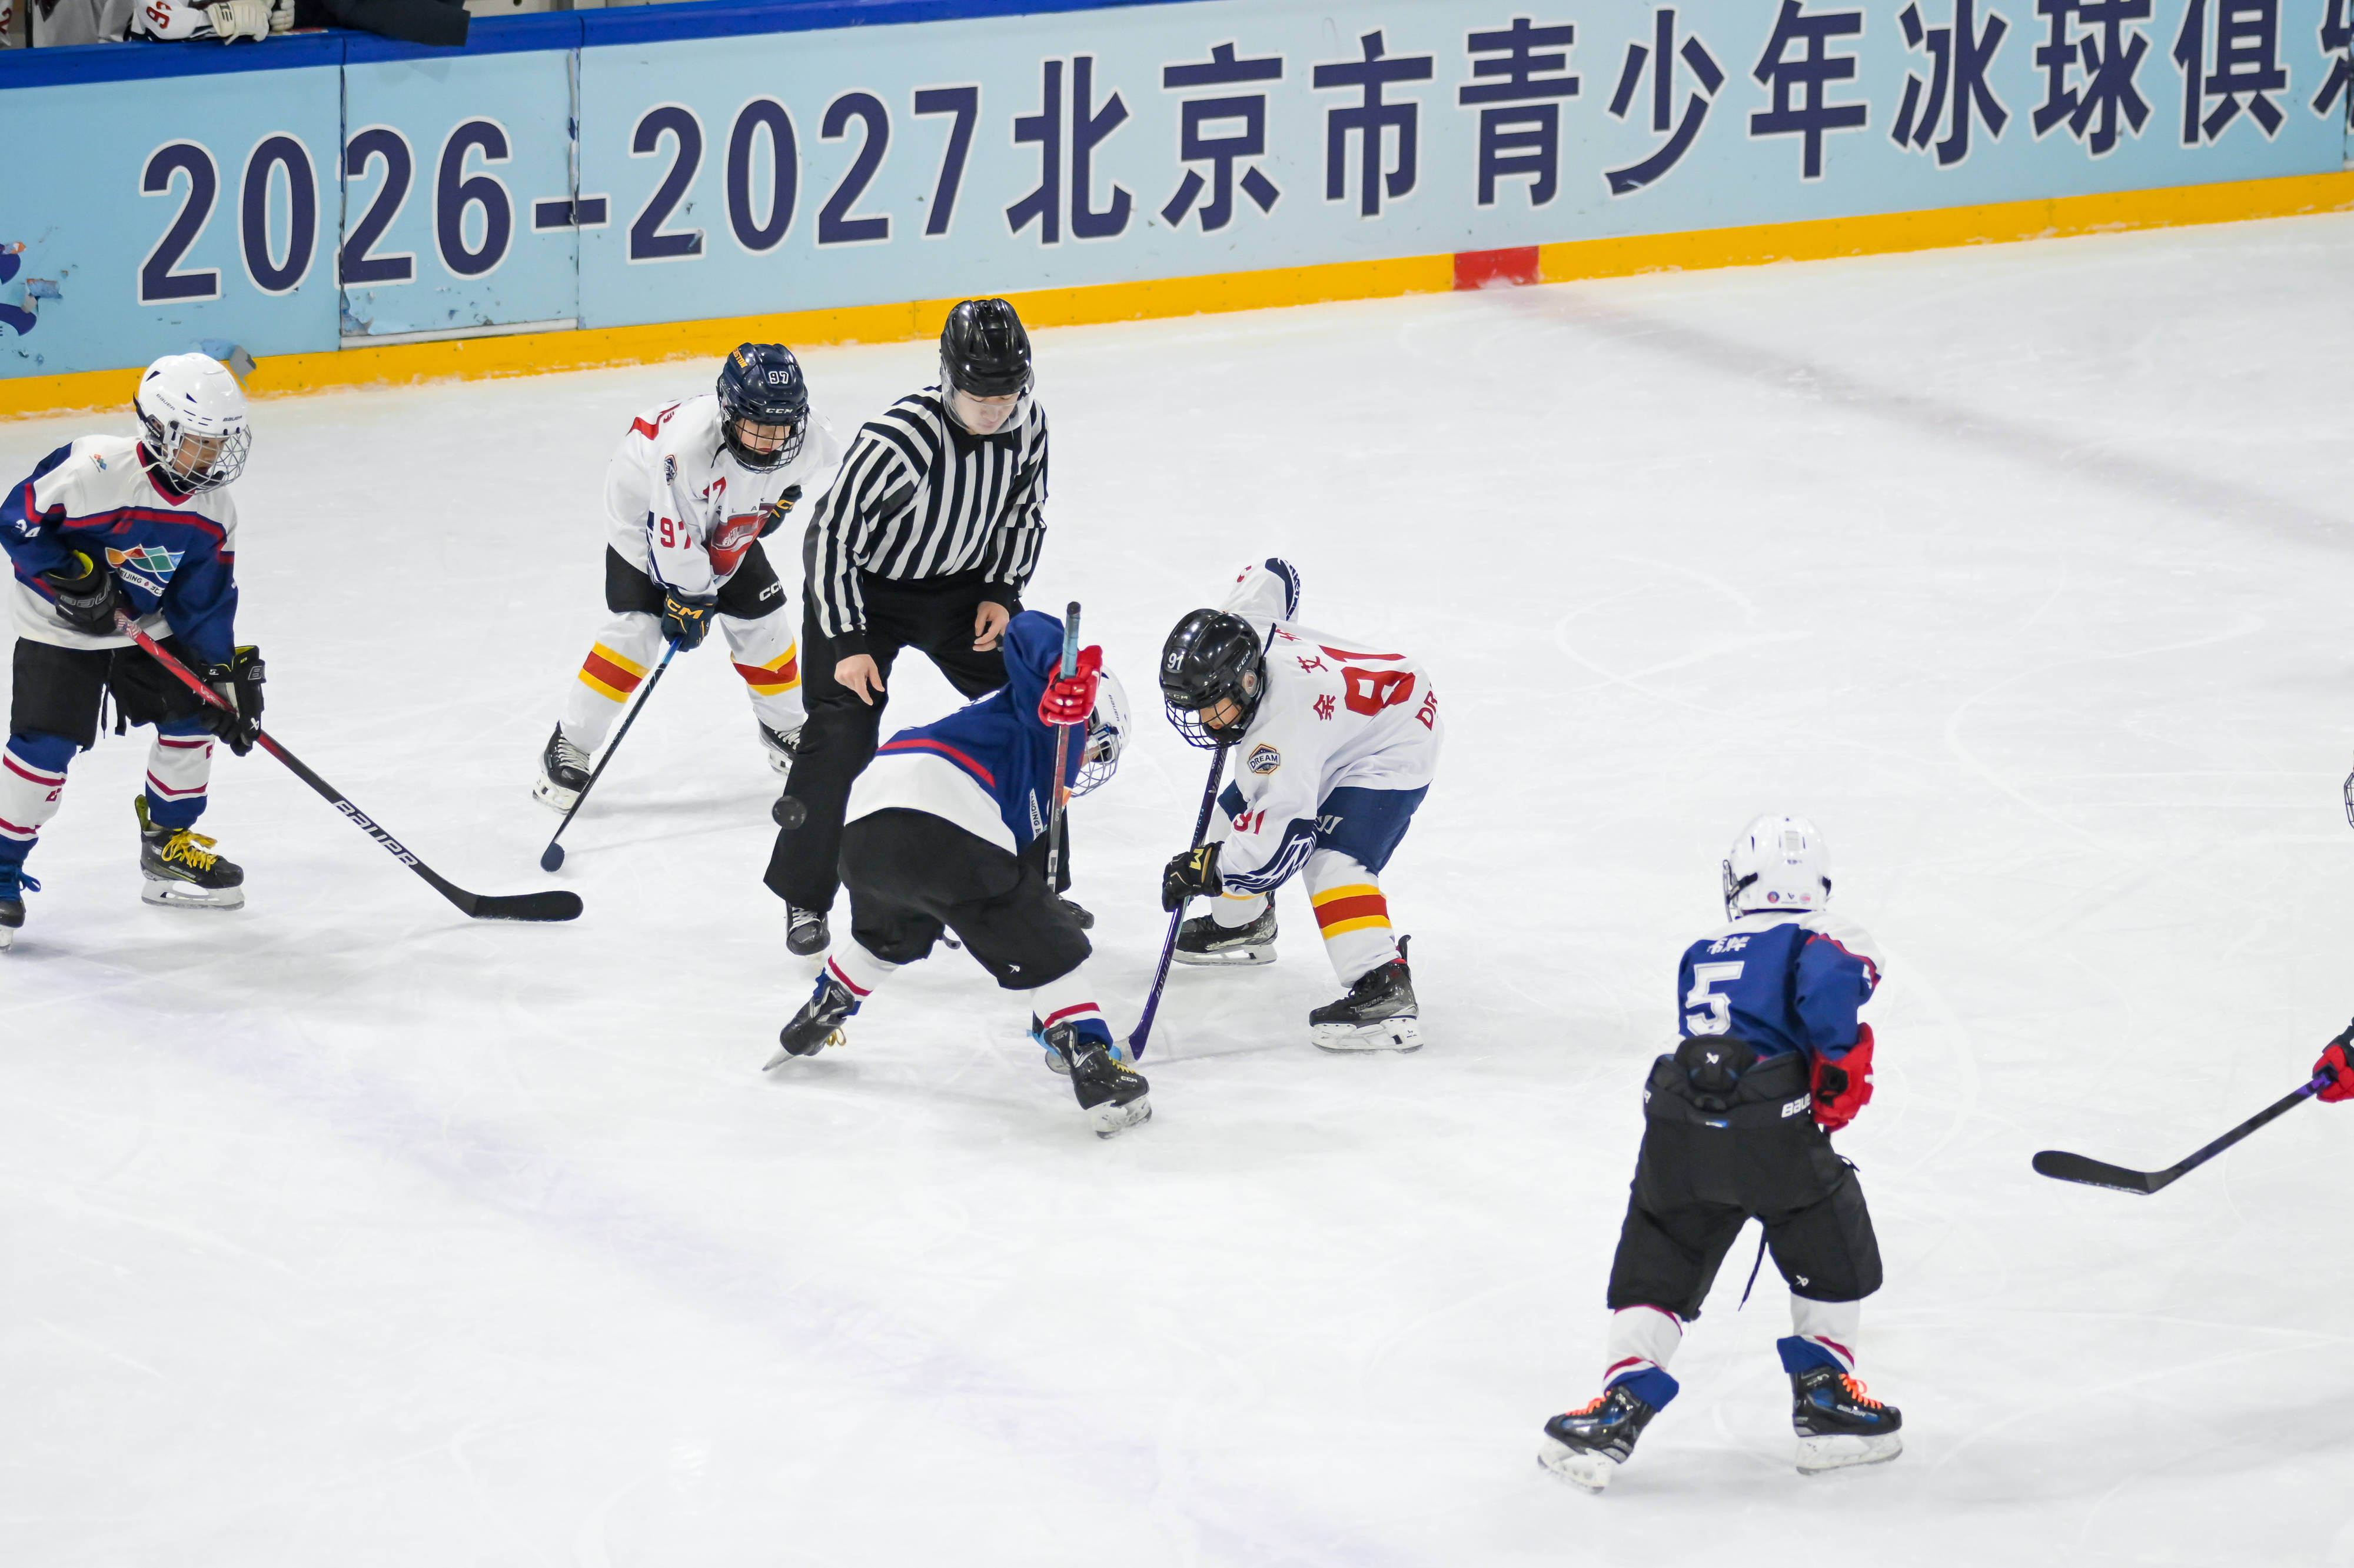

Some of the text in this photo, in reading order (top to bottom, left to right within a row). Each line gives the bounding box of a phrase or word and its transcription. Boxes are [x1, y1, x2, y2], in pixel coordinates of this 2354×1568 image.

[768, 371, 789, 384] 97
[155, 393, 176, 411] BAUER
[660, 517, 692, 550] 97
[119, 570, 142, 584] EIJING
[149, 585, 165, 596] 北
[666, 593, 704, 620] CM
[1167, 652, 1184, 670] 91
[1236, 650, 1251, 672] CCM
[1108, 694, 1121, 722] BAUER
[1212, 745, 1230, 787] BAUE
[1249, 754, 1278, 770] DREAM
[333, 800, 418, 867] BAUER
[1685, 960, 1745, 1036] 5
[1781, 1092, 1812, 1118] BAUE
